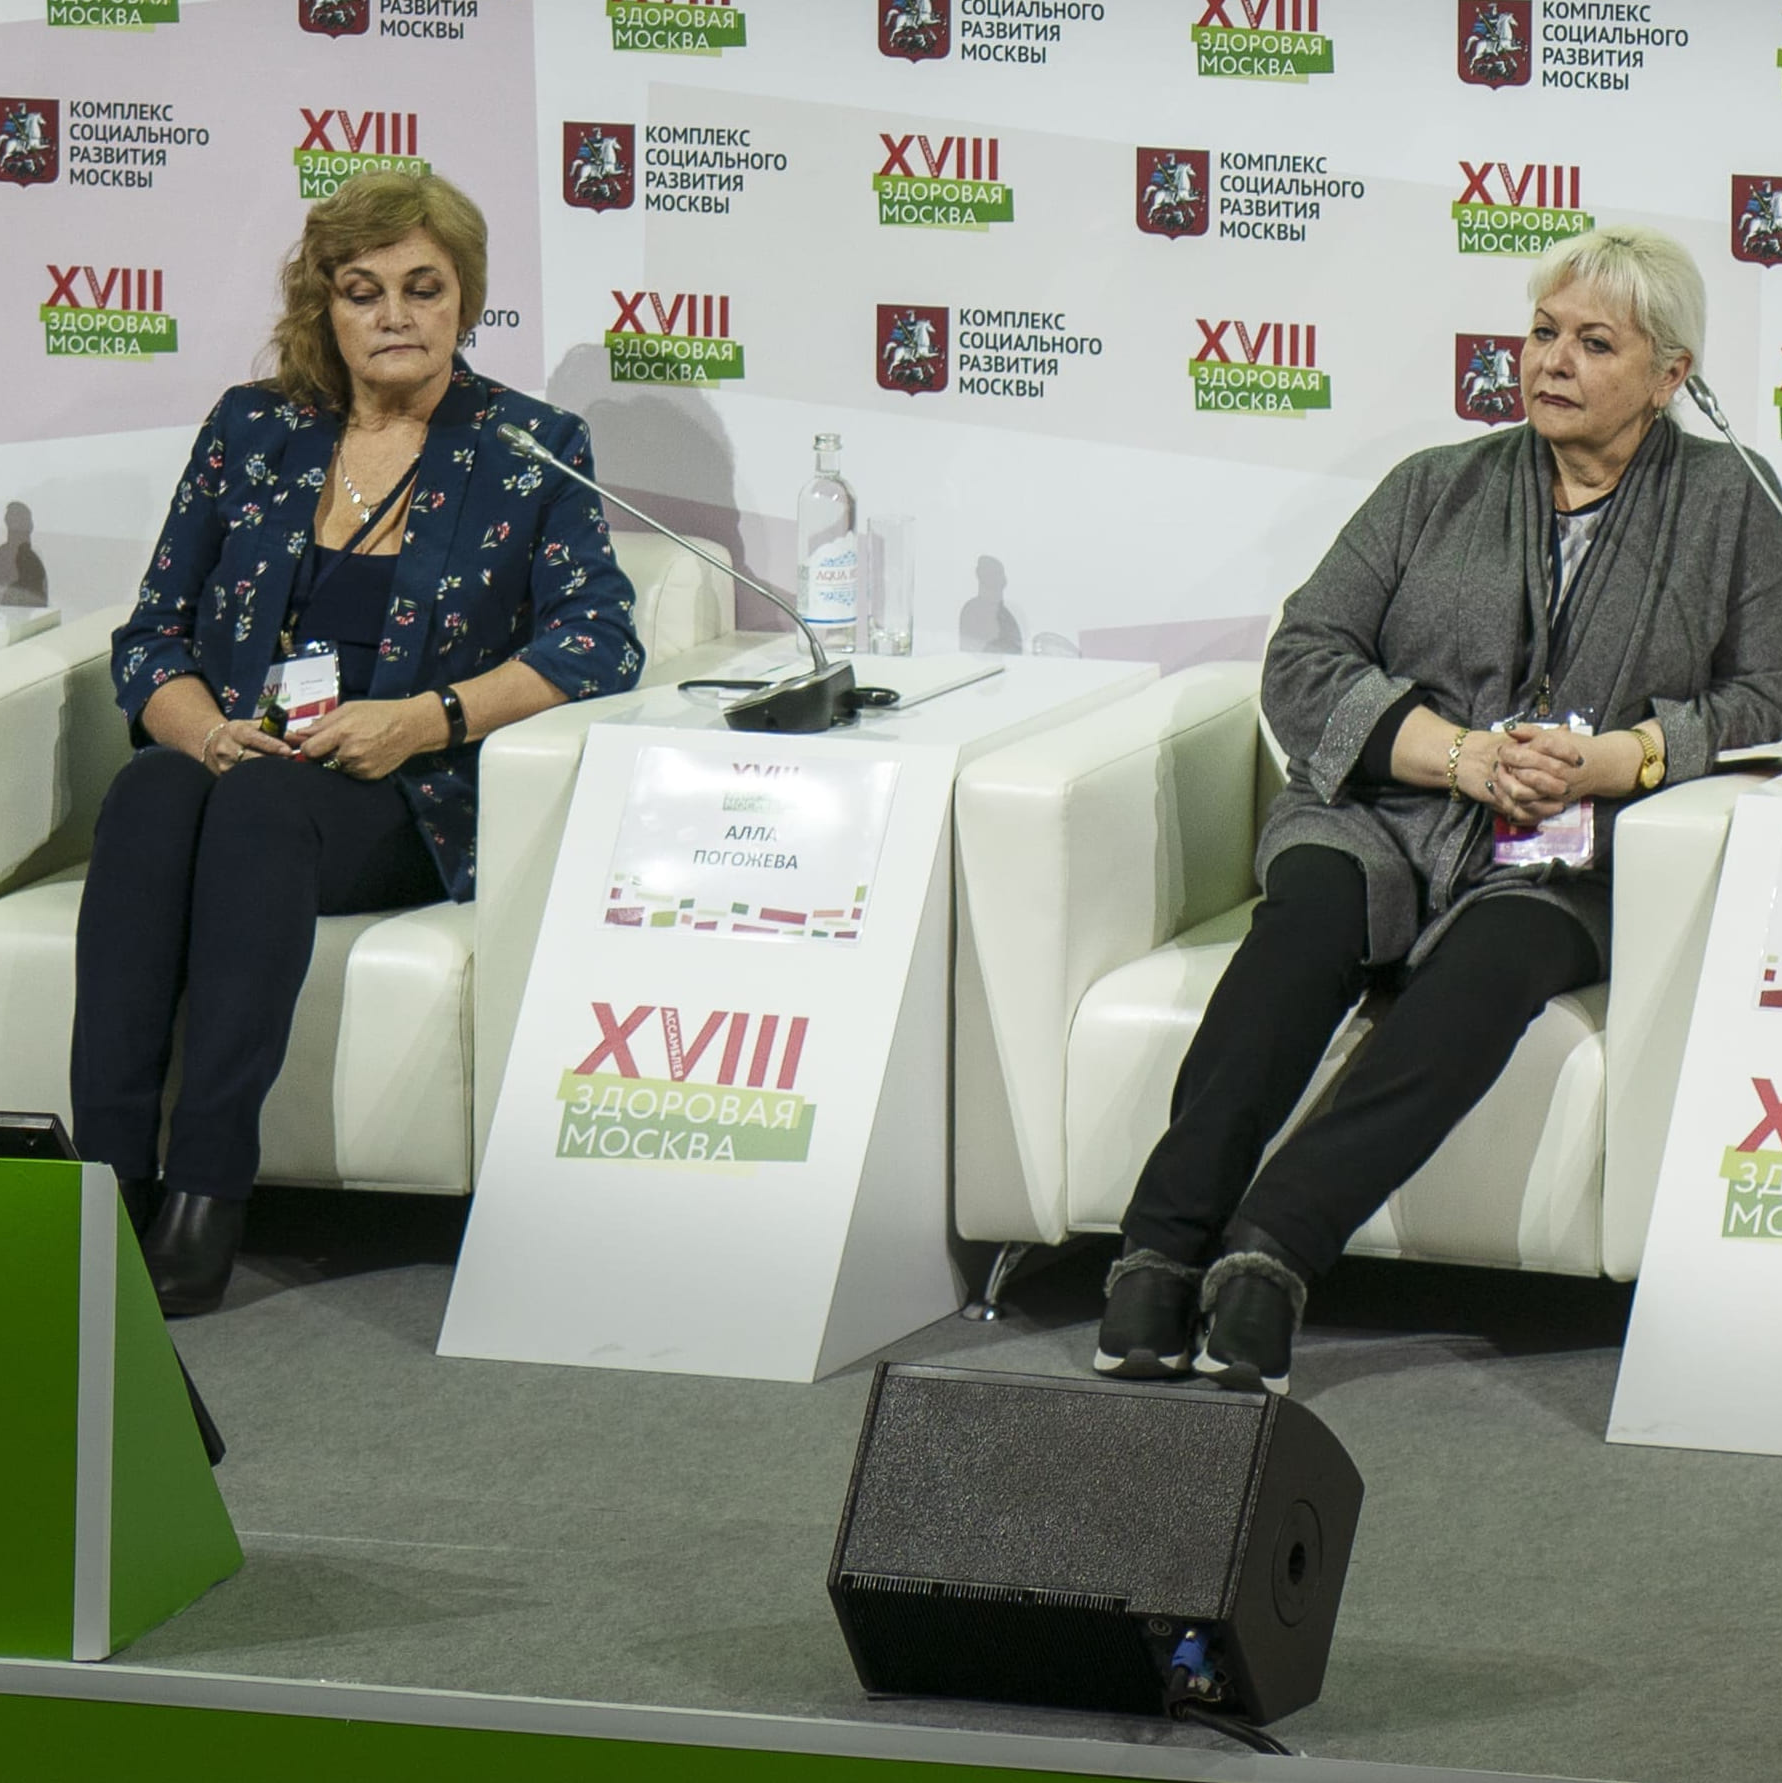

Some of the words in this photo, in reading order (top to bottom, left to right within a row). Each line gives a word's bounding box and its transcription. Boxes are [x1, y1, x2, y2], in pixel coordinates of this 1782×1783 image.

[50, 5, 143, 24] МОСКВА
[1542, 0, 1651, 23] КОМПЛЕКС
[380, 18, 464, 40] МОСКВЫ
[1542, 23, 1689, 48] СОЦИАЛЬНОГО
[1199, 33, 1323, 54] ЗДОРОВАЯ
[1200, 55, 1297, 74] МОСКВА
[1542, 46, 1644, 69] РАЗВИТИЯ
[1542, 69, 1629, 91] МОСКВЫ
[69, 100, 174, 123] КОМПЛЕКС
[69, 122, 210, 147] СОЦИАЛЬНОГО
[69, 145, 167, 167] РАЗВИТИЯ
[880, 134, 997, 181] XVIII
[1220, 151, 1328, 175] КОМПЛЕКС
[69, 167, 153, 189] МОСКВЫ
[1219, 174, 1365, 199] СОЦИАЛЬНОГО
[881, 182, 1003, 203] ЗДОРОВАЯ
[882, 204, 978, 223] МОСКВА
[1219, 197, 1320, 220] РАЗВИТИЯ
[1219, 220, 1306, 242] МОСКВЫ
[46, 264, 162, 312] XVIII
[47, 311, 168, 333] ЗДОРОВАЯ
[612, 291, 728, 338] XVIII
[959, 308, 1066, 332] КОМПЛЕКС
[48, 333, 143, 352] МОСКВА
[613, 338, 734, 360] ЗДОРОВАЯ
[958, 330, 1103, 356] СОЦИАЛЬНОГО
[614, 360, 709, 379] МОСКВА
[959, 353, 1059, 376] РАЗВИТИЯ
[958, 376, 1044, 398] МОСКВЫ
[724, 825, 778, 842] АЛЛА
[693, 849, 799, 870] ПОГОЖЕВА
[573, 1002, 809, 1089] XVIII
[665, 1009, 684, 1079] АССАМБЛЕЯ
[570, 1084, 797, 1130] ЗДОРОВАЯ
[561, 1123, 736, 1162] МОСКВА
